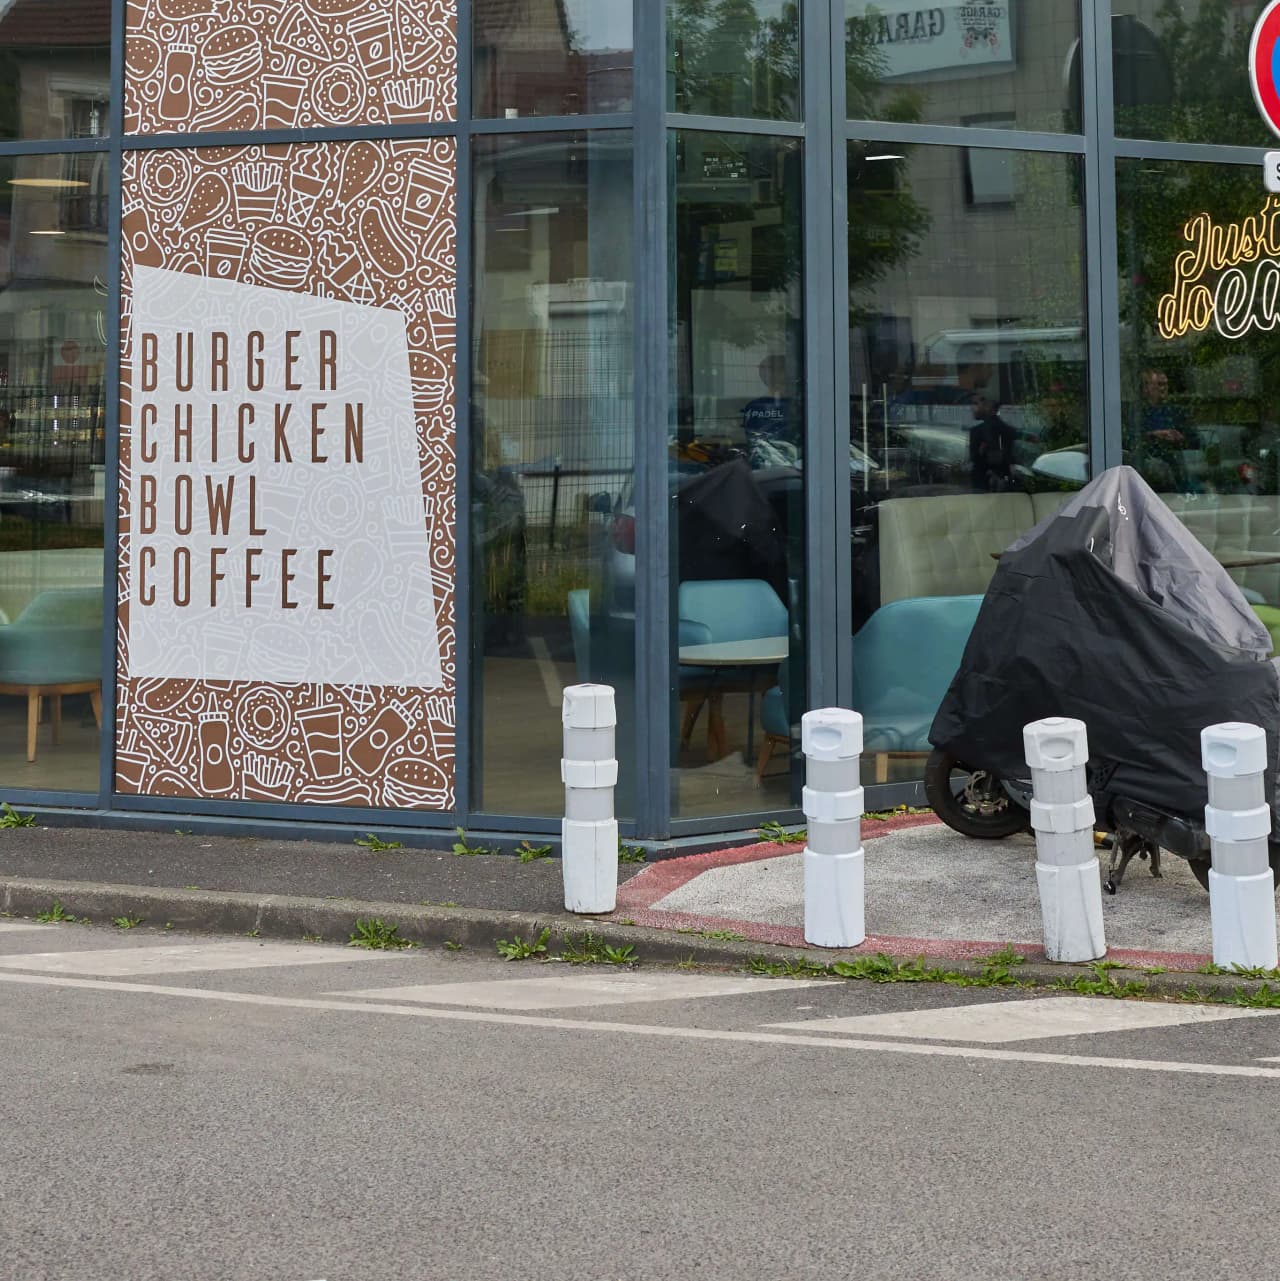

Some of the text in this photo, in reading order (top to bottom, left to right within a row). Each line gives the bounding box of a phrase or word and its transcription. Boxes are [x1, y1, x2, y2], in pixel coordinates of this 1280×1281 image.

[141, 330, 337, 392] BURGER
[140, 403, 363, 463] CHICKEN
[140, 475, 267, 536] BOWL
[139, 546, 334, 610] COFFEE
